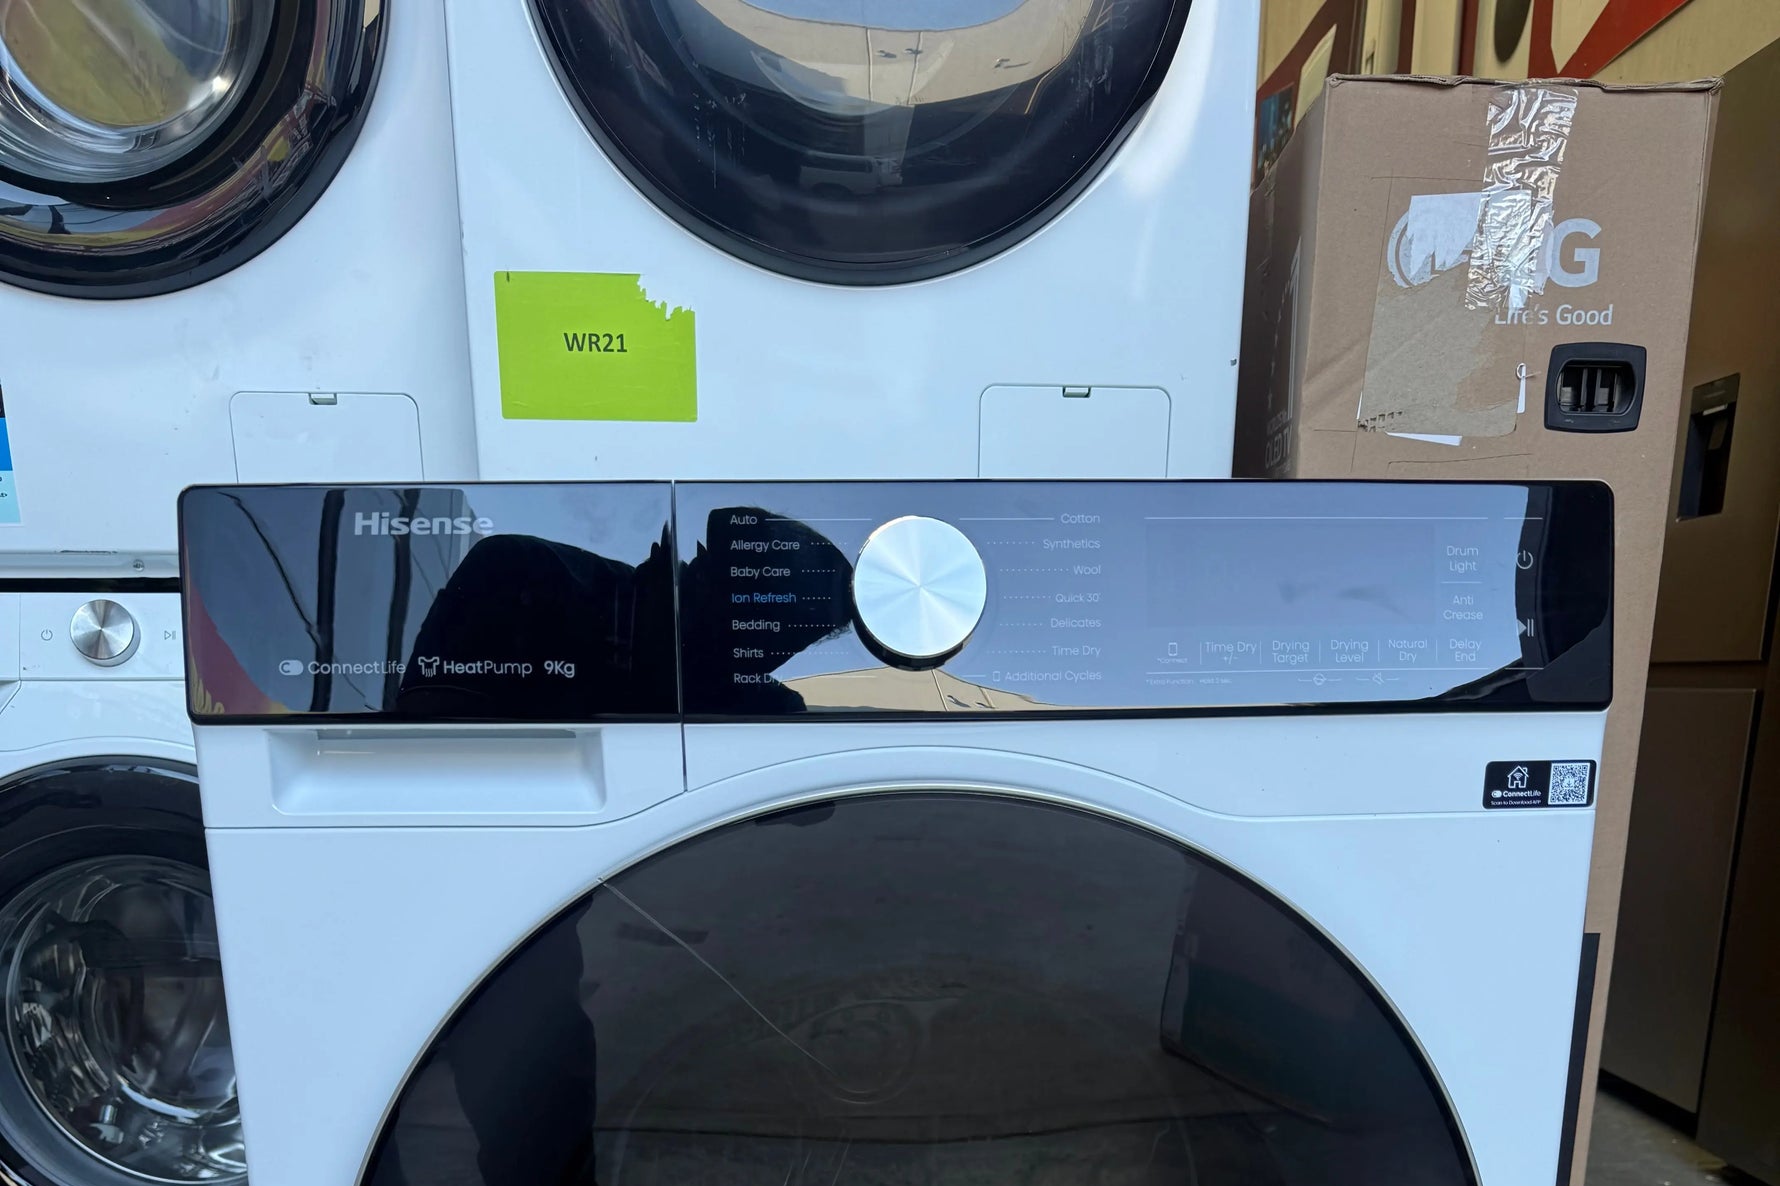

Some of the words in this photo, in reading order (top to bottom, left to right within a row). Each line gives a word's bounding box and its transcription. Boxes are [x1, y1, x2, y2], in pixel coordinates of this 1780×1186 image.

[1555, 303, 1614, 326] Good
[563, 332, 628, 353] WR21
[354, 511, 494, 536] Hisense
[729, 514, 758, 525] Auto
[1060, 512, 1101, 524] Cotton
[729, 539, 770, 553] Allergy
[771, 539, 801, 551] Care
[1042, 538, 1101, 552] Synthetics
[1446, 545, 1479, 557] Drum
[729, 566, 760, 580] Baby
[762, 566, 791, 577] Care
[1072, 564, 1102, 575] Wool
[1449, 559, 1479, 574] Light
[731, 593, 751, 604] Ion
[753, 592, 797, 604] Refresh
[1055, 592, 1086, 604] Quick
[1453, 594, 1474, 606] Anti
[1442, 609, 1484, 621] Crease
[731, 619, 781, 633] Bedding
[1050, 617, 1102, 629] Delicates
[1204, 641, 1235, 653] Time
[1237, 641, 1258, 655] Dry
[1272, 640, 1310, 653] Drying
[1330, 639, 1369, 653] Drying
[1388, 638, 1428, 650] Natural
[1449, 638, 1482, 651] Delay
[733, 647, 764, 659] Shirts
[1052, 645, 1080, 656] Time
[1082, 645, 1102, 659] Dry
[1271, 652, 1310, 665] Target
[1334, 652, 1364, 664] Level
[1398, 651, 1418, 663] Dry
[1454, 652, 1477, 663] End
[307, 659, 408, 675] ConnectLife
[443, 660, 533, 678] HeatPump
[543, 660, 576, 679] 9Kg
[733, 672, 762, 684] Rack
[763, 672, 784, 687] Dry
[1004, 670, 1062, 682] Additional
[1064, 669, 1103, 684] Cycles
[1503, 789, 1542, 798] ConnectLife
